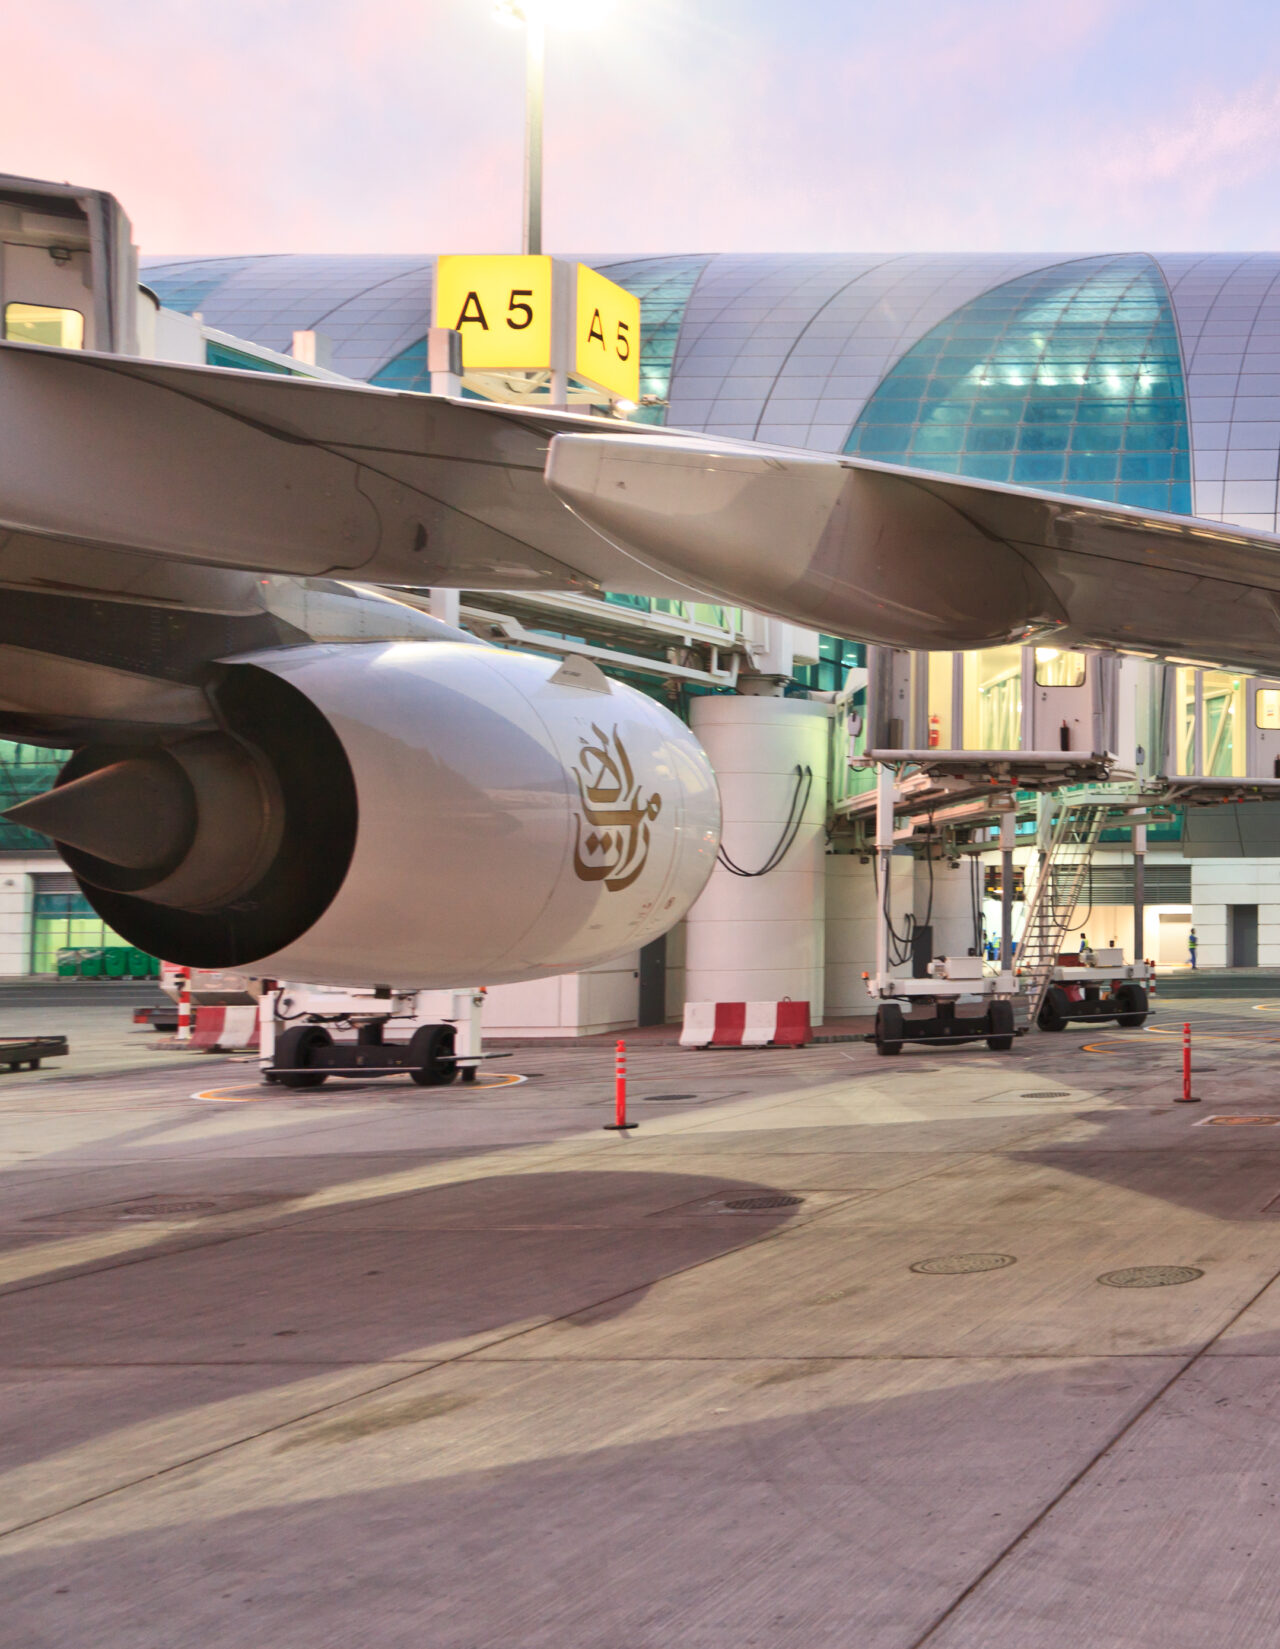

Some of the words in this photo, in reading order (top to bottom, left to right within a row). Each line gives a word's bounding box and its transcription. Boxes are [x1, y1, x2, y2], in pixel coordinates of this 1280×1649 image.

[455, 291, 489, 331] A
[506, 289, 533, 330] 5
[587, 308, 606, 351] A
[616, 320, 630, 361] 5
